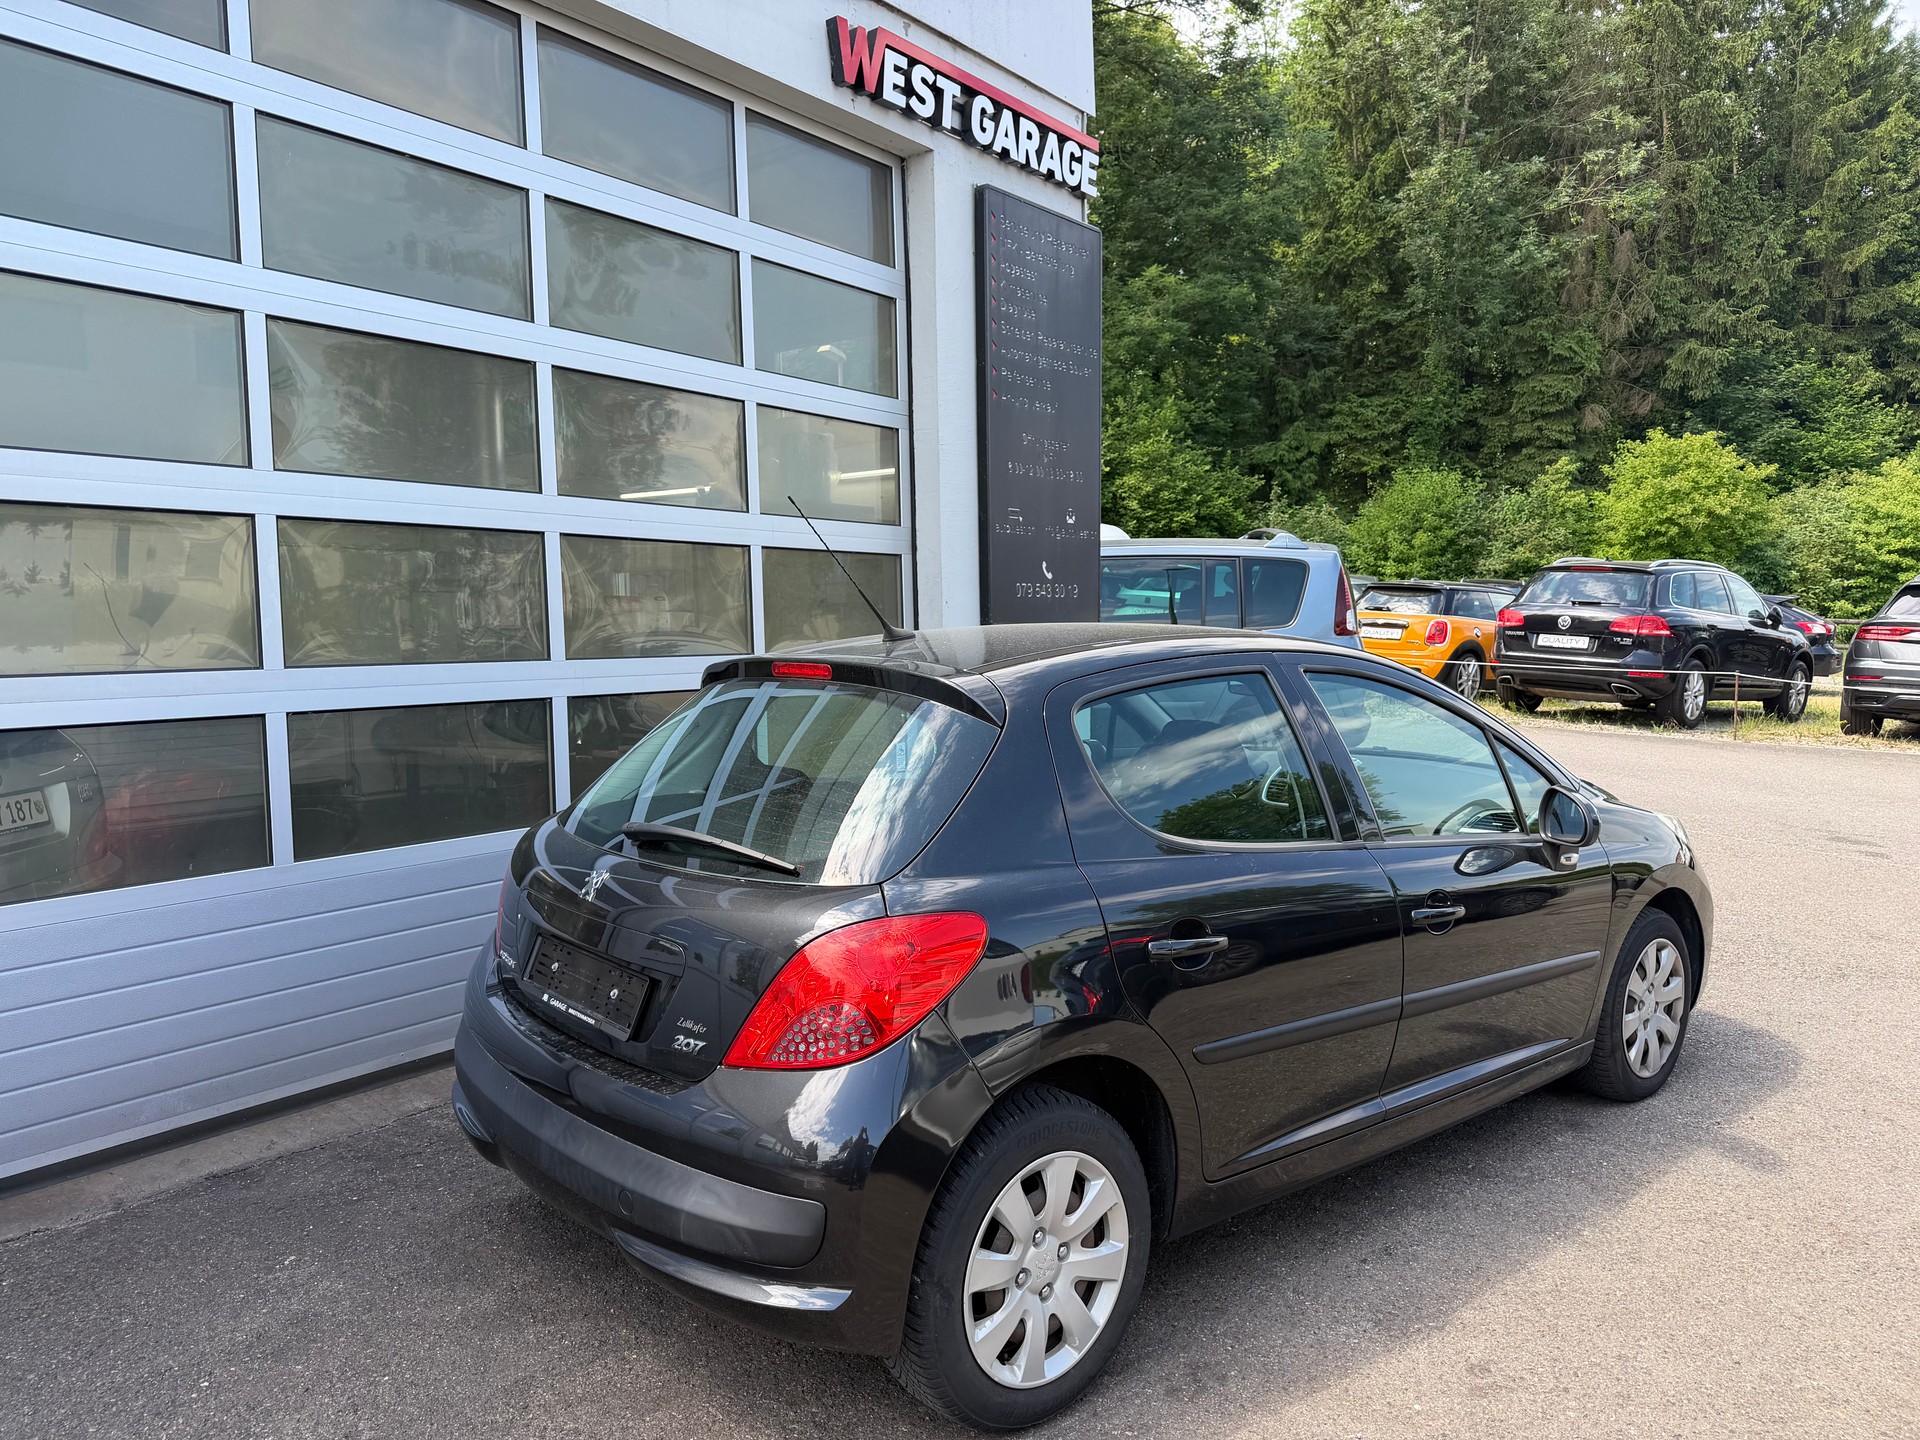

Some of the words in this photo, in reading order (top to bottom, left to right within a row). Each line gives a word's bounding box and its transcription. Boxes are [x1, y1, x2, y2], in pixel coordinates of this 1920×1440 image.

[830, 15, 961, 130] WEST
[971, 94, 1099, 198] GARAGE
[1016, 582, 1032, 597] 079
[1036, 583, 1051, 597] 543
[1055, 583, 1065, 598] 30
[1541, 636, 1581, 645] QUALITY
[671, 1034, 708, 1055] 207
